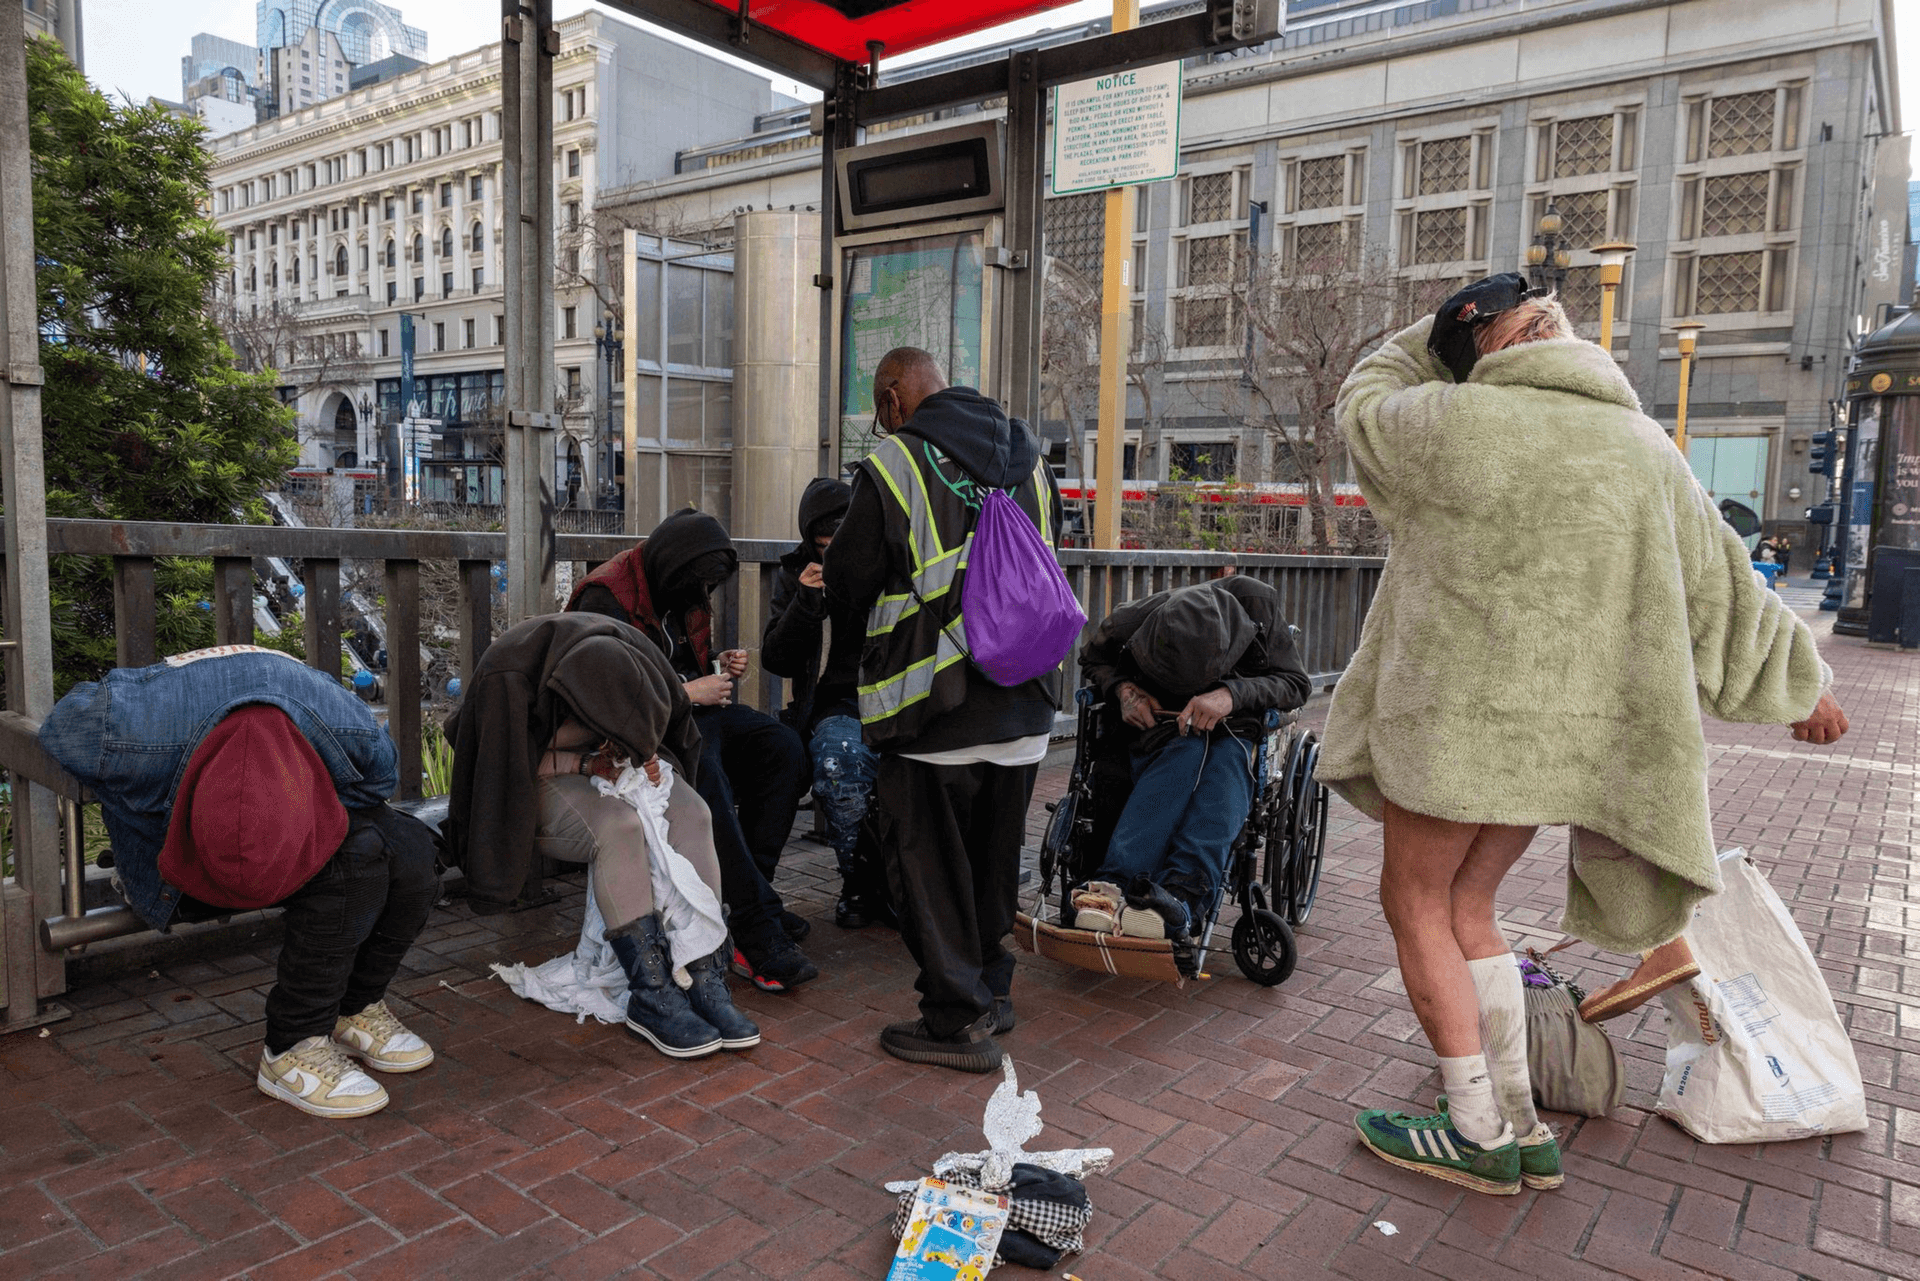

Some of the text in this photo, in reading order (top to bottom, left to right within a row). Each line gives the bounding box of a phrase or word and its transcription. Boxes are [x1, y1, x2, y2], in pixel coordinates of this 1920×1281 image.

[1097, 74, 1136, 91] NOTICE
[1077, 96, 1102, 106] UNLAWFUL
[1125, 88, 1144, 97] PERSON
[1080, 105, 1101, 113] BETWEEN
[1113, 99, 1130, 108] HOURS
[1137, 104, 1159, 113] WITHOUT
[1088, 121, 1109, 129] STATION
[1112, 125, 1139, 135] MONUMENT
[1149, 121, 1166, 129] OTHER
[1064, 142, 1091, 151] STRUCTURE
[1141, 129, 1168, 139] INCLUDING
[1095, 147, 1116, 155] WITHOUT
[1117, 141, 1148, 151] PERMISSION
[1080, 156, 1110, 166] RECREATION
[1896, 480, 1918, 490] you
